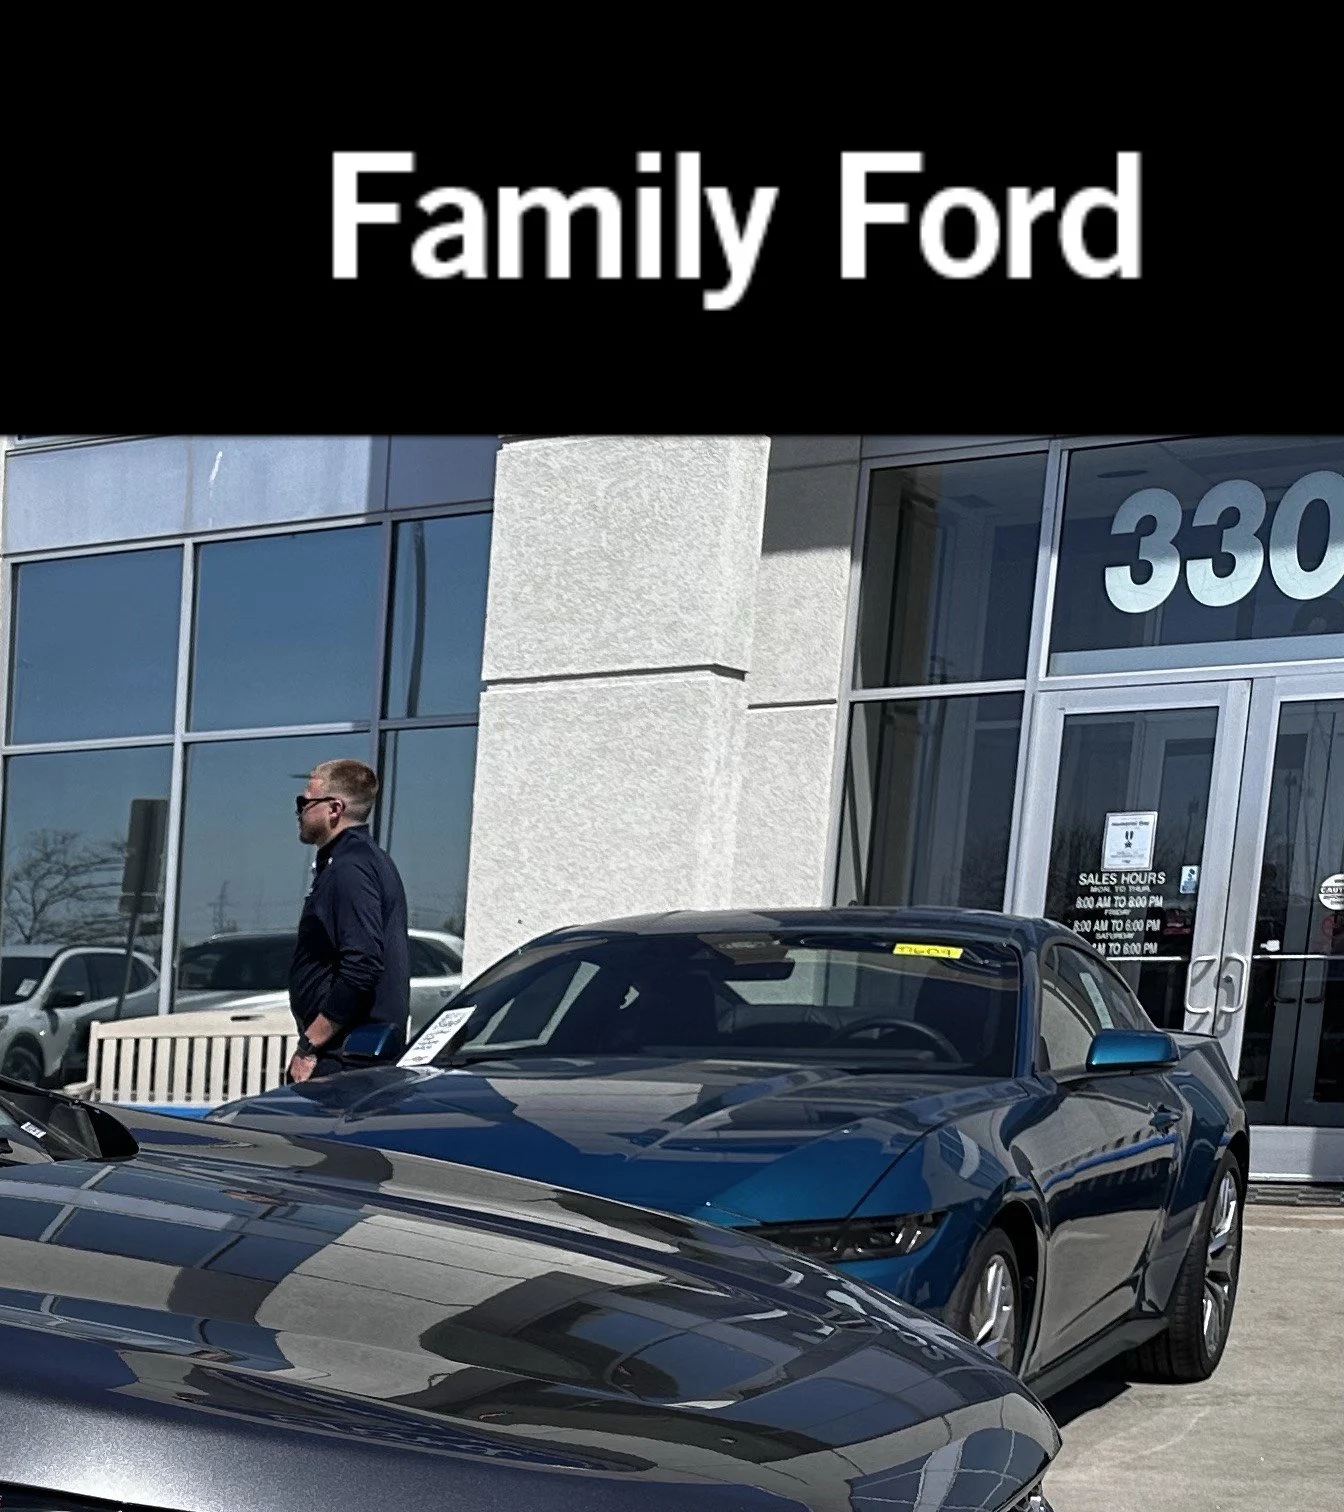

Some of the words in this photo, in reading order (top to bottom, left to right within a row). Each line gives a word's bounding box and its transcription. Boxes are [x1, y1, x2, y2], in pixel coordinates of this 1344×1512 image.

[1105, 470, 1344, 614] 330
[1078, 872, 1118, 886] SALES
[1120, 871, 1166, 885] HOURS
[1095, 896, 1112, 908] AM
[1114, 896, 1127, 908] TO
[1149, 895, 1163, 907] PM
[1093, 920, 1109, 932] AM
[1111, 919, 1124, 931] TO
[1146, 919, 1161, 931] PM
[1108, 943, 1121, 955] TO
[1143, 942, 1158, 954] PM
